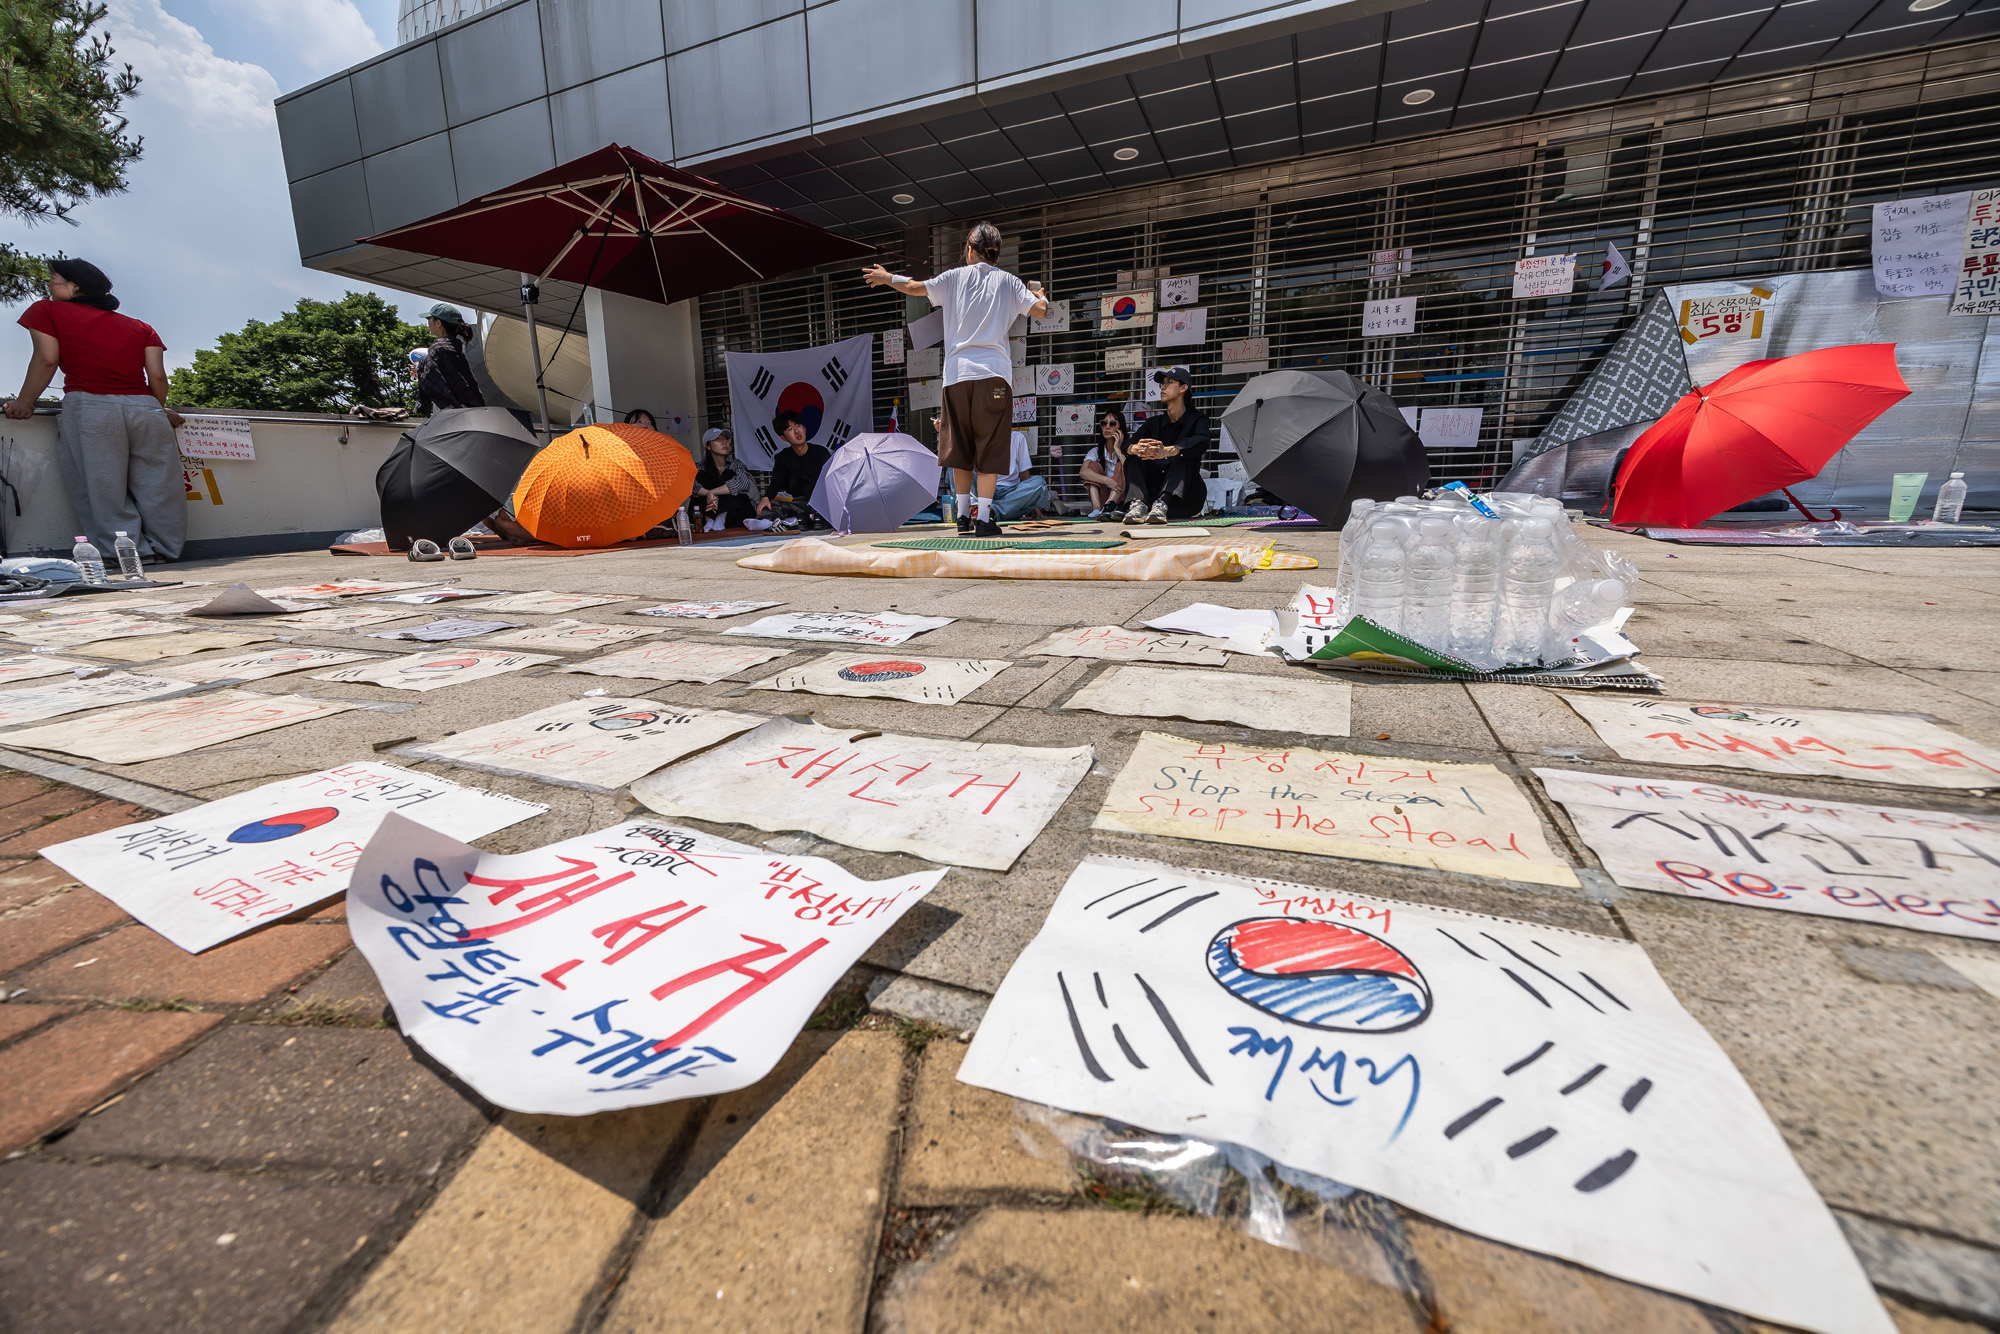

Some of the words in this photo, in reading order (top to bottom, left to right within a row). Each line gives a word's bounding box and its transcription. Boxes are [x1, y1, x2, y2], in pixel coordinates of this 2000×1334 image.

[1519, 258, 1547, 270] 부정선거
[1519, 267, 1565, 281] 자유대한민국
[1963, 253, 2000, 278] 투표
[1166, 279, 1192, 289] 재선거
[1959, 276, 2000, 300] 국민
[1690, 301, 1717, 317] 최소
[1717, 297, 1761, 314] 상주인원
[1427, 414, 1475, 438] 재선거
[300, 766, 446, 809] 부정선거
[745, 746, 1022, 815] 재선거
[1154, 766, 1240, 802] Stop
[1259, 784, 1319, 801] the
[1586, 780, 1683, 800] WE
[1124, 795, 1247, 832] Stop
[1264, 805, 1340, 836] the
[116, 826, 233, 871] 재선거
[309, 841, 363, 872] STO
[254, 860, 327, 886] THE
[618, 850, 695, 876] CBDC
[463, 854, 831, 1054] 재선거
